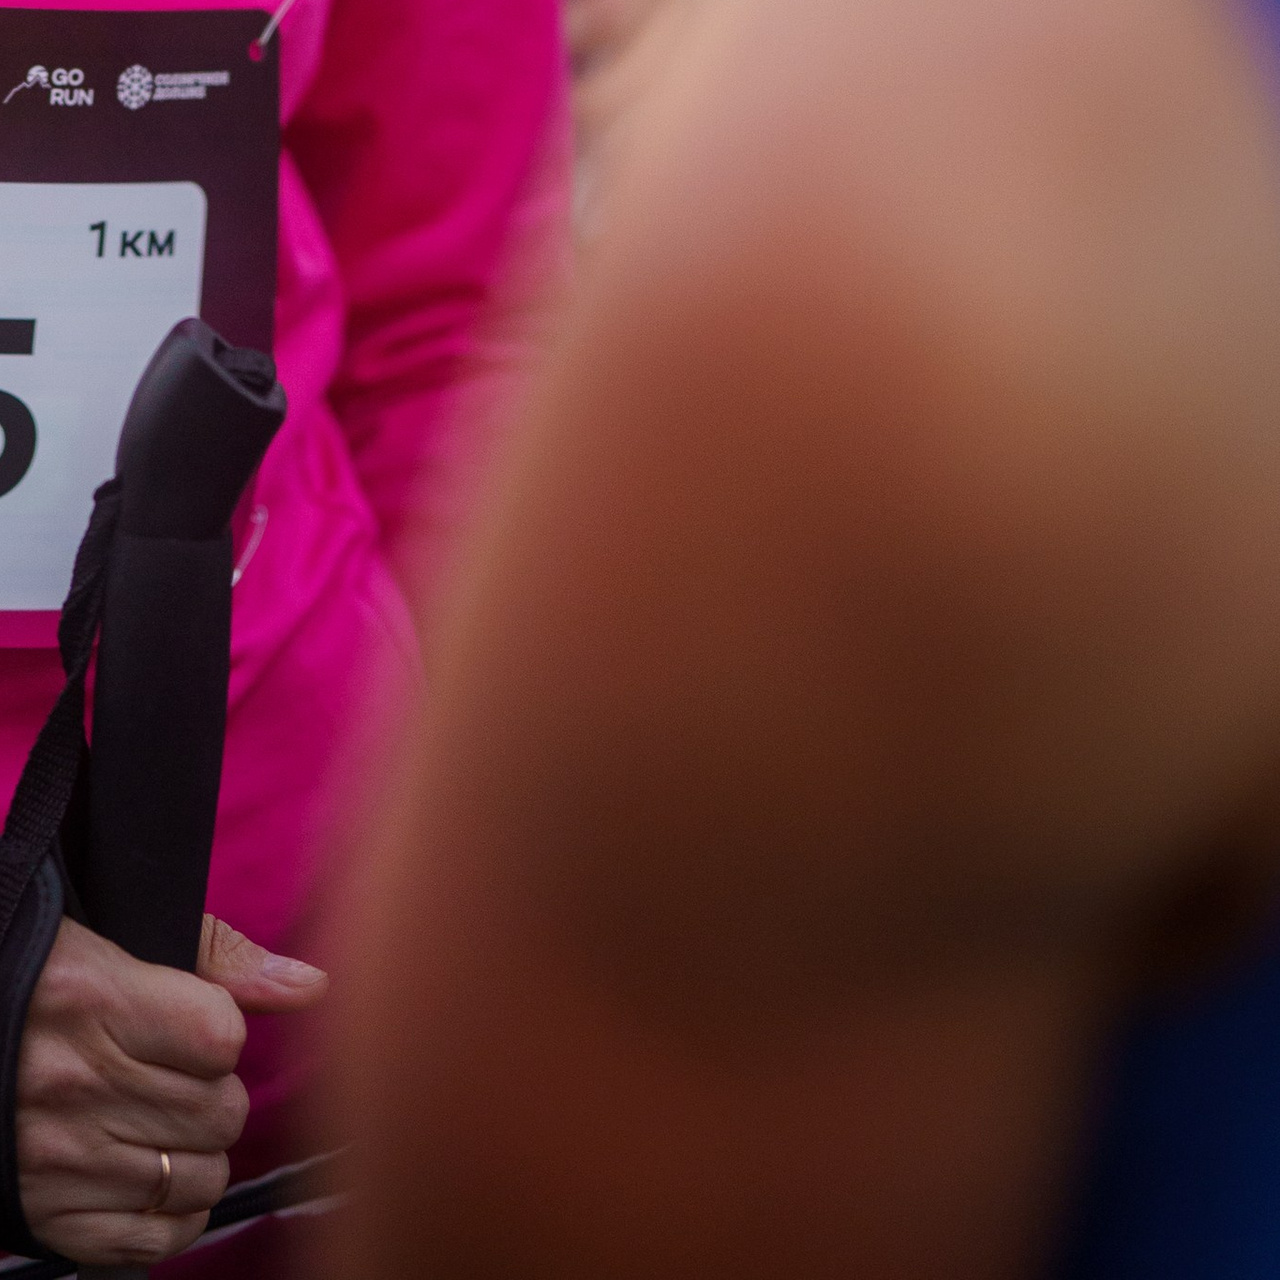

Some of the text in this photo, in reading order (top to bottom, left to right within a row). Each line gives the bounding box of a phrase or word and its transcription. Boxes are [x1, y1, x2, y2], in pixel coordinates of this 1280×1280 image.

[51, 67, 85, 87] GO
[49, 88, 95, 107] RUN
[89, 220, 106, 258] 1
